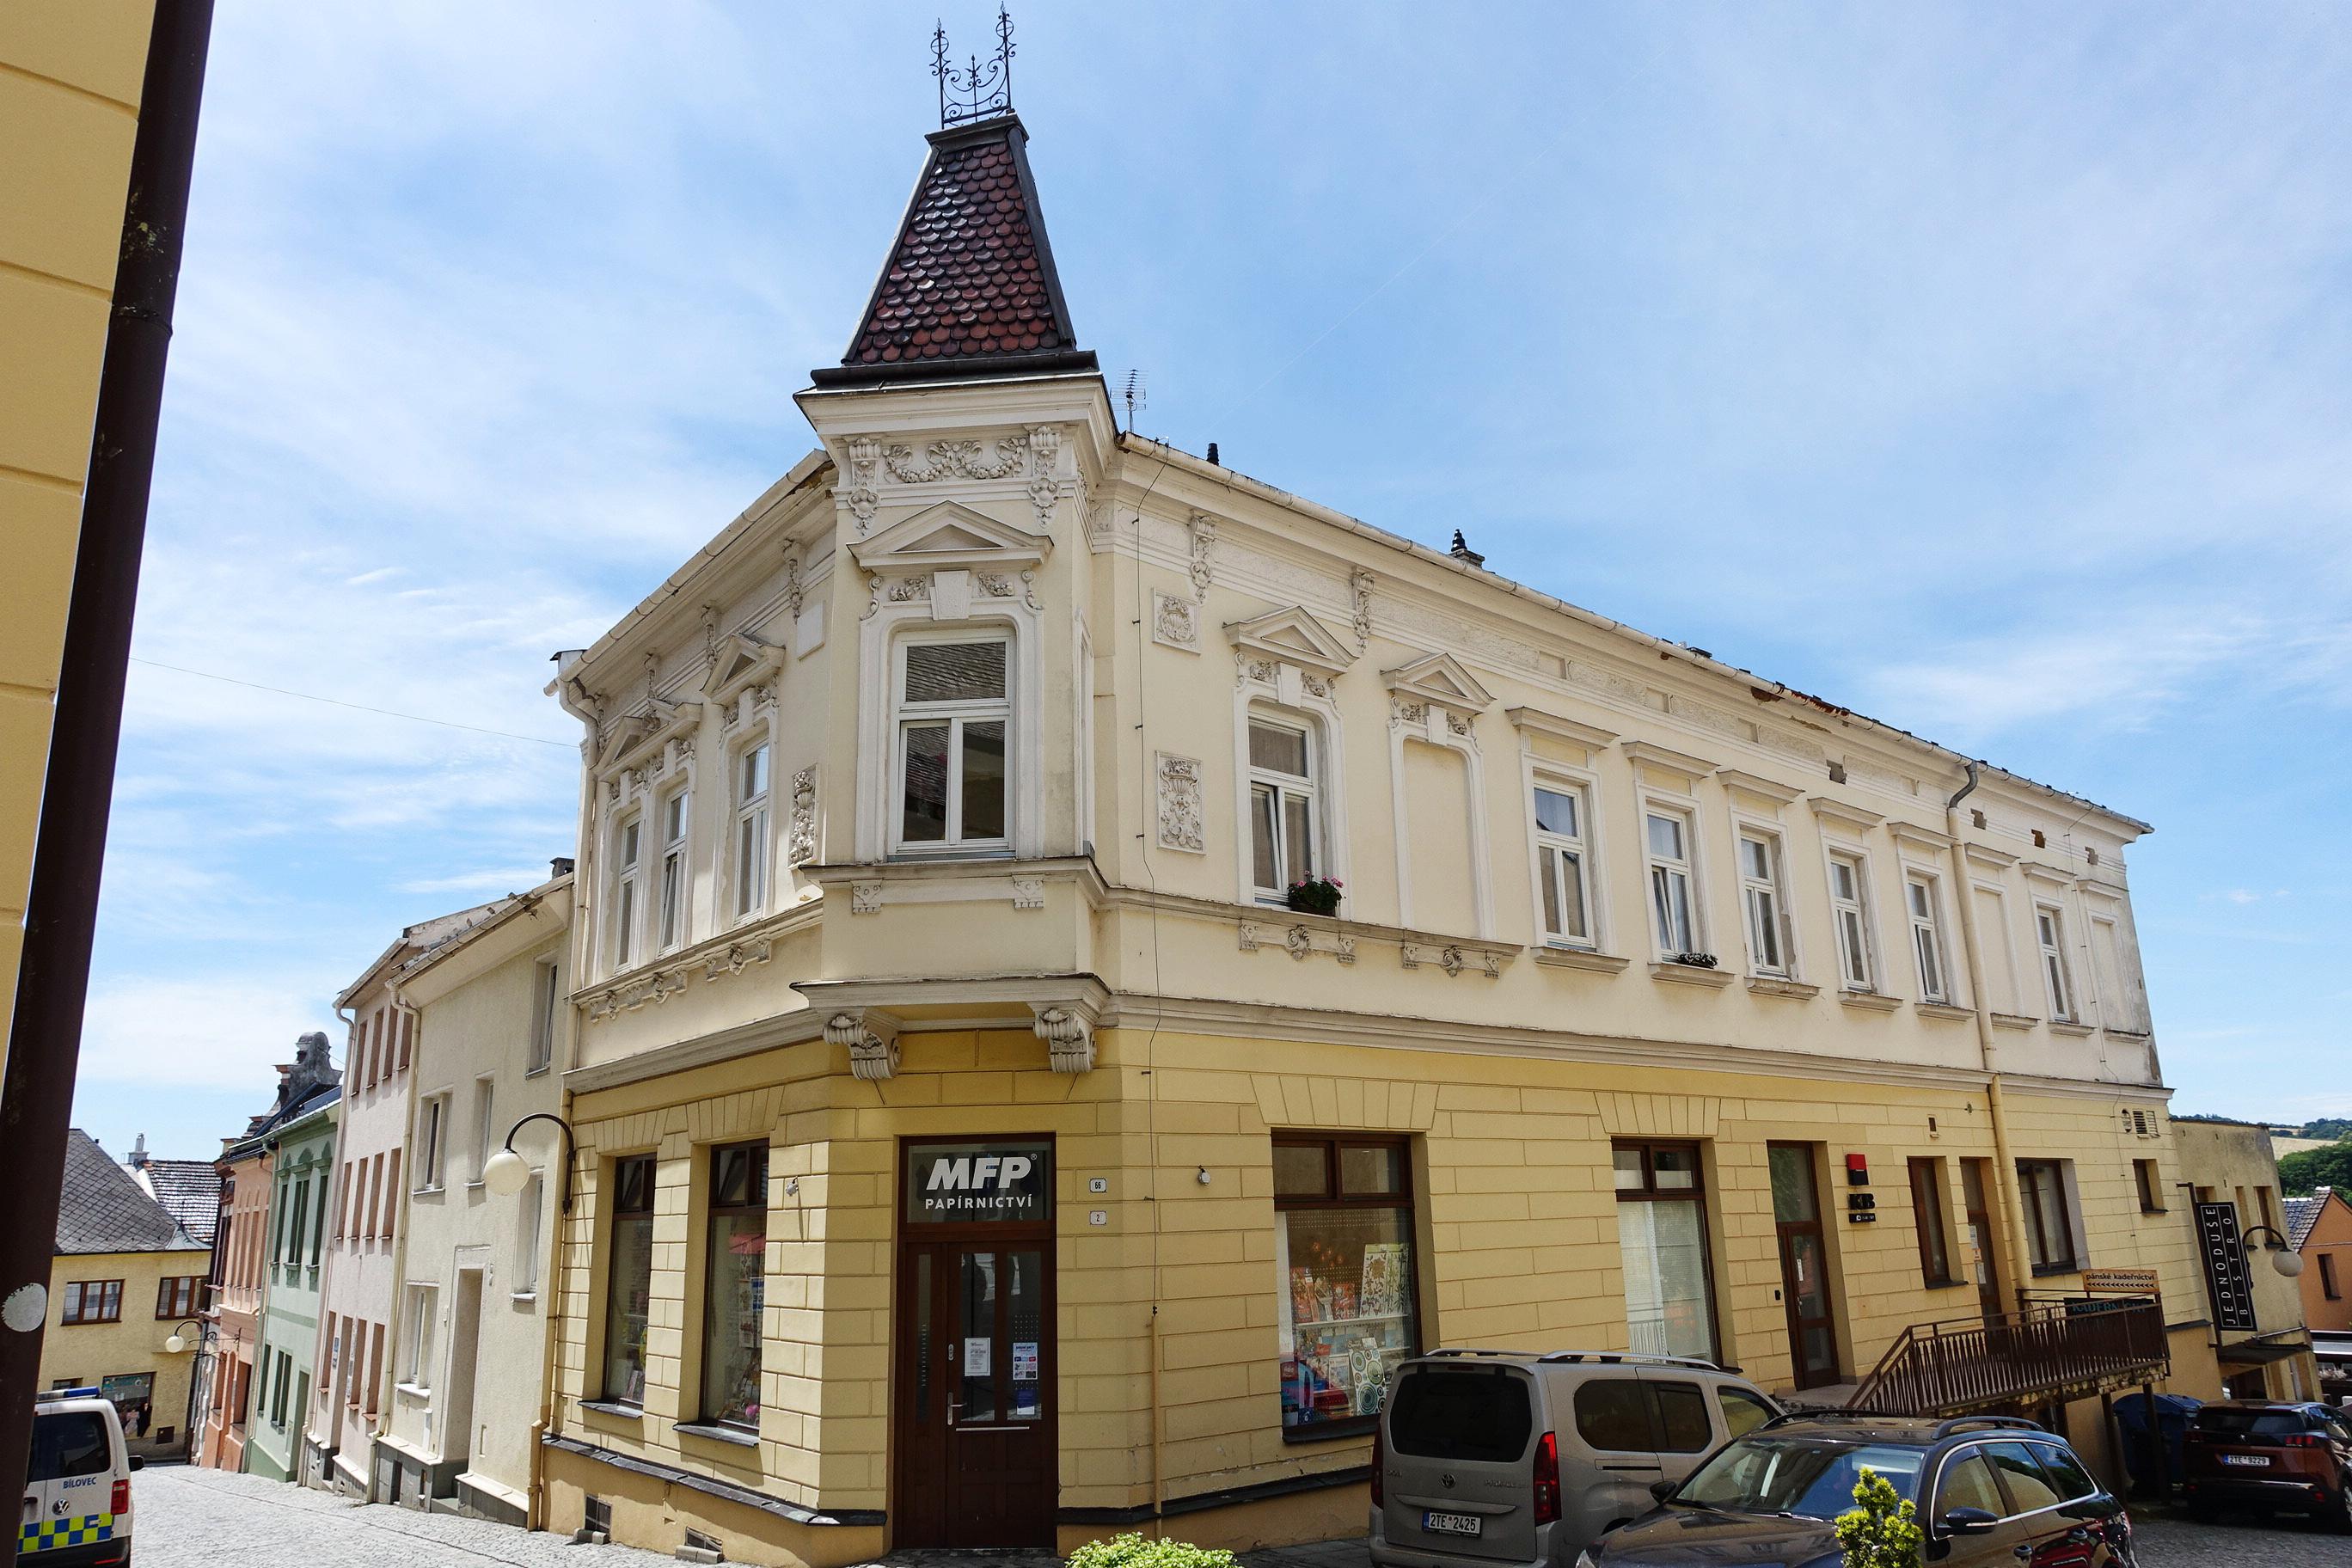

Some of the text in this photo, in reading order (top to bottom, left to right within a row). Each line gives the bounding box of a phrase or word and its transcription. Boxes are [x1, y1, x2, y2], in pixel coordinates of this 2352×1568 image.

[926, 1156, 1032, 1191] MFP
[925, 1193, 1032, 1210] PAPÍRNICTVÍ
[1096, 1214, 1100, 1222] 2
[2205, 1208, 2236, 1325] JEDNODUŠE
[2222, 1217, 2249, 1316] BISTRO
[63, 1477, 97, 1489] BÍLOVEC
[1430, 1514, 1476, 1532] 2TE 2425
